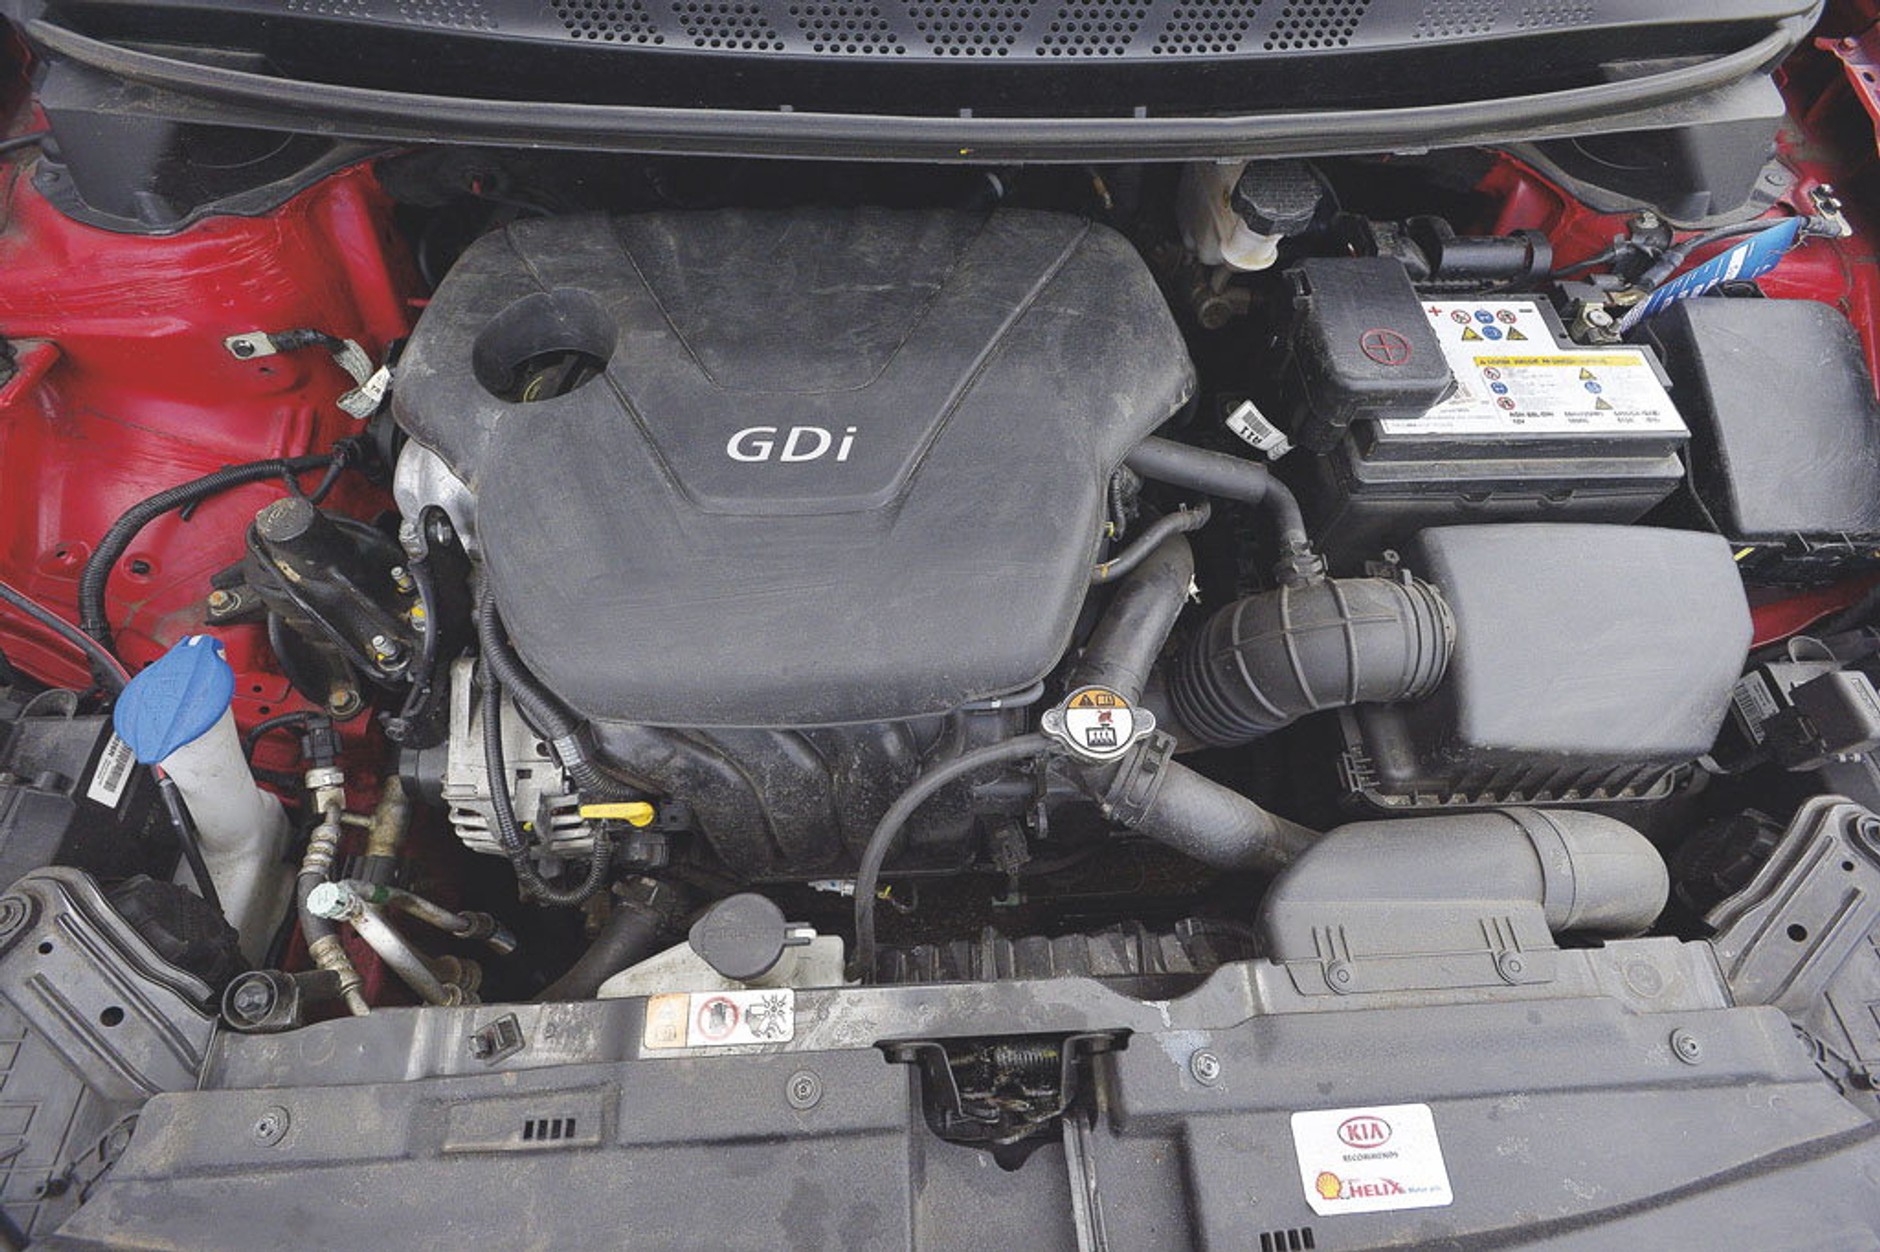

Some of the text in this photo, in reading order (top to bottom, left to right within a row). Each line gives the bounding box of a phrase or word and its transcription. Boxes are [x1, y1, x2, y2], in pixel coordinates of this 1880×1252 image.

[727, 426, 857, 462] GDi
[1346, 1123, 1384, 1142] KIA
[1349, 1177, 1407, 1198] HELIX
